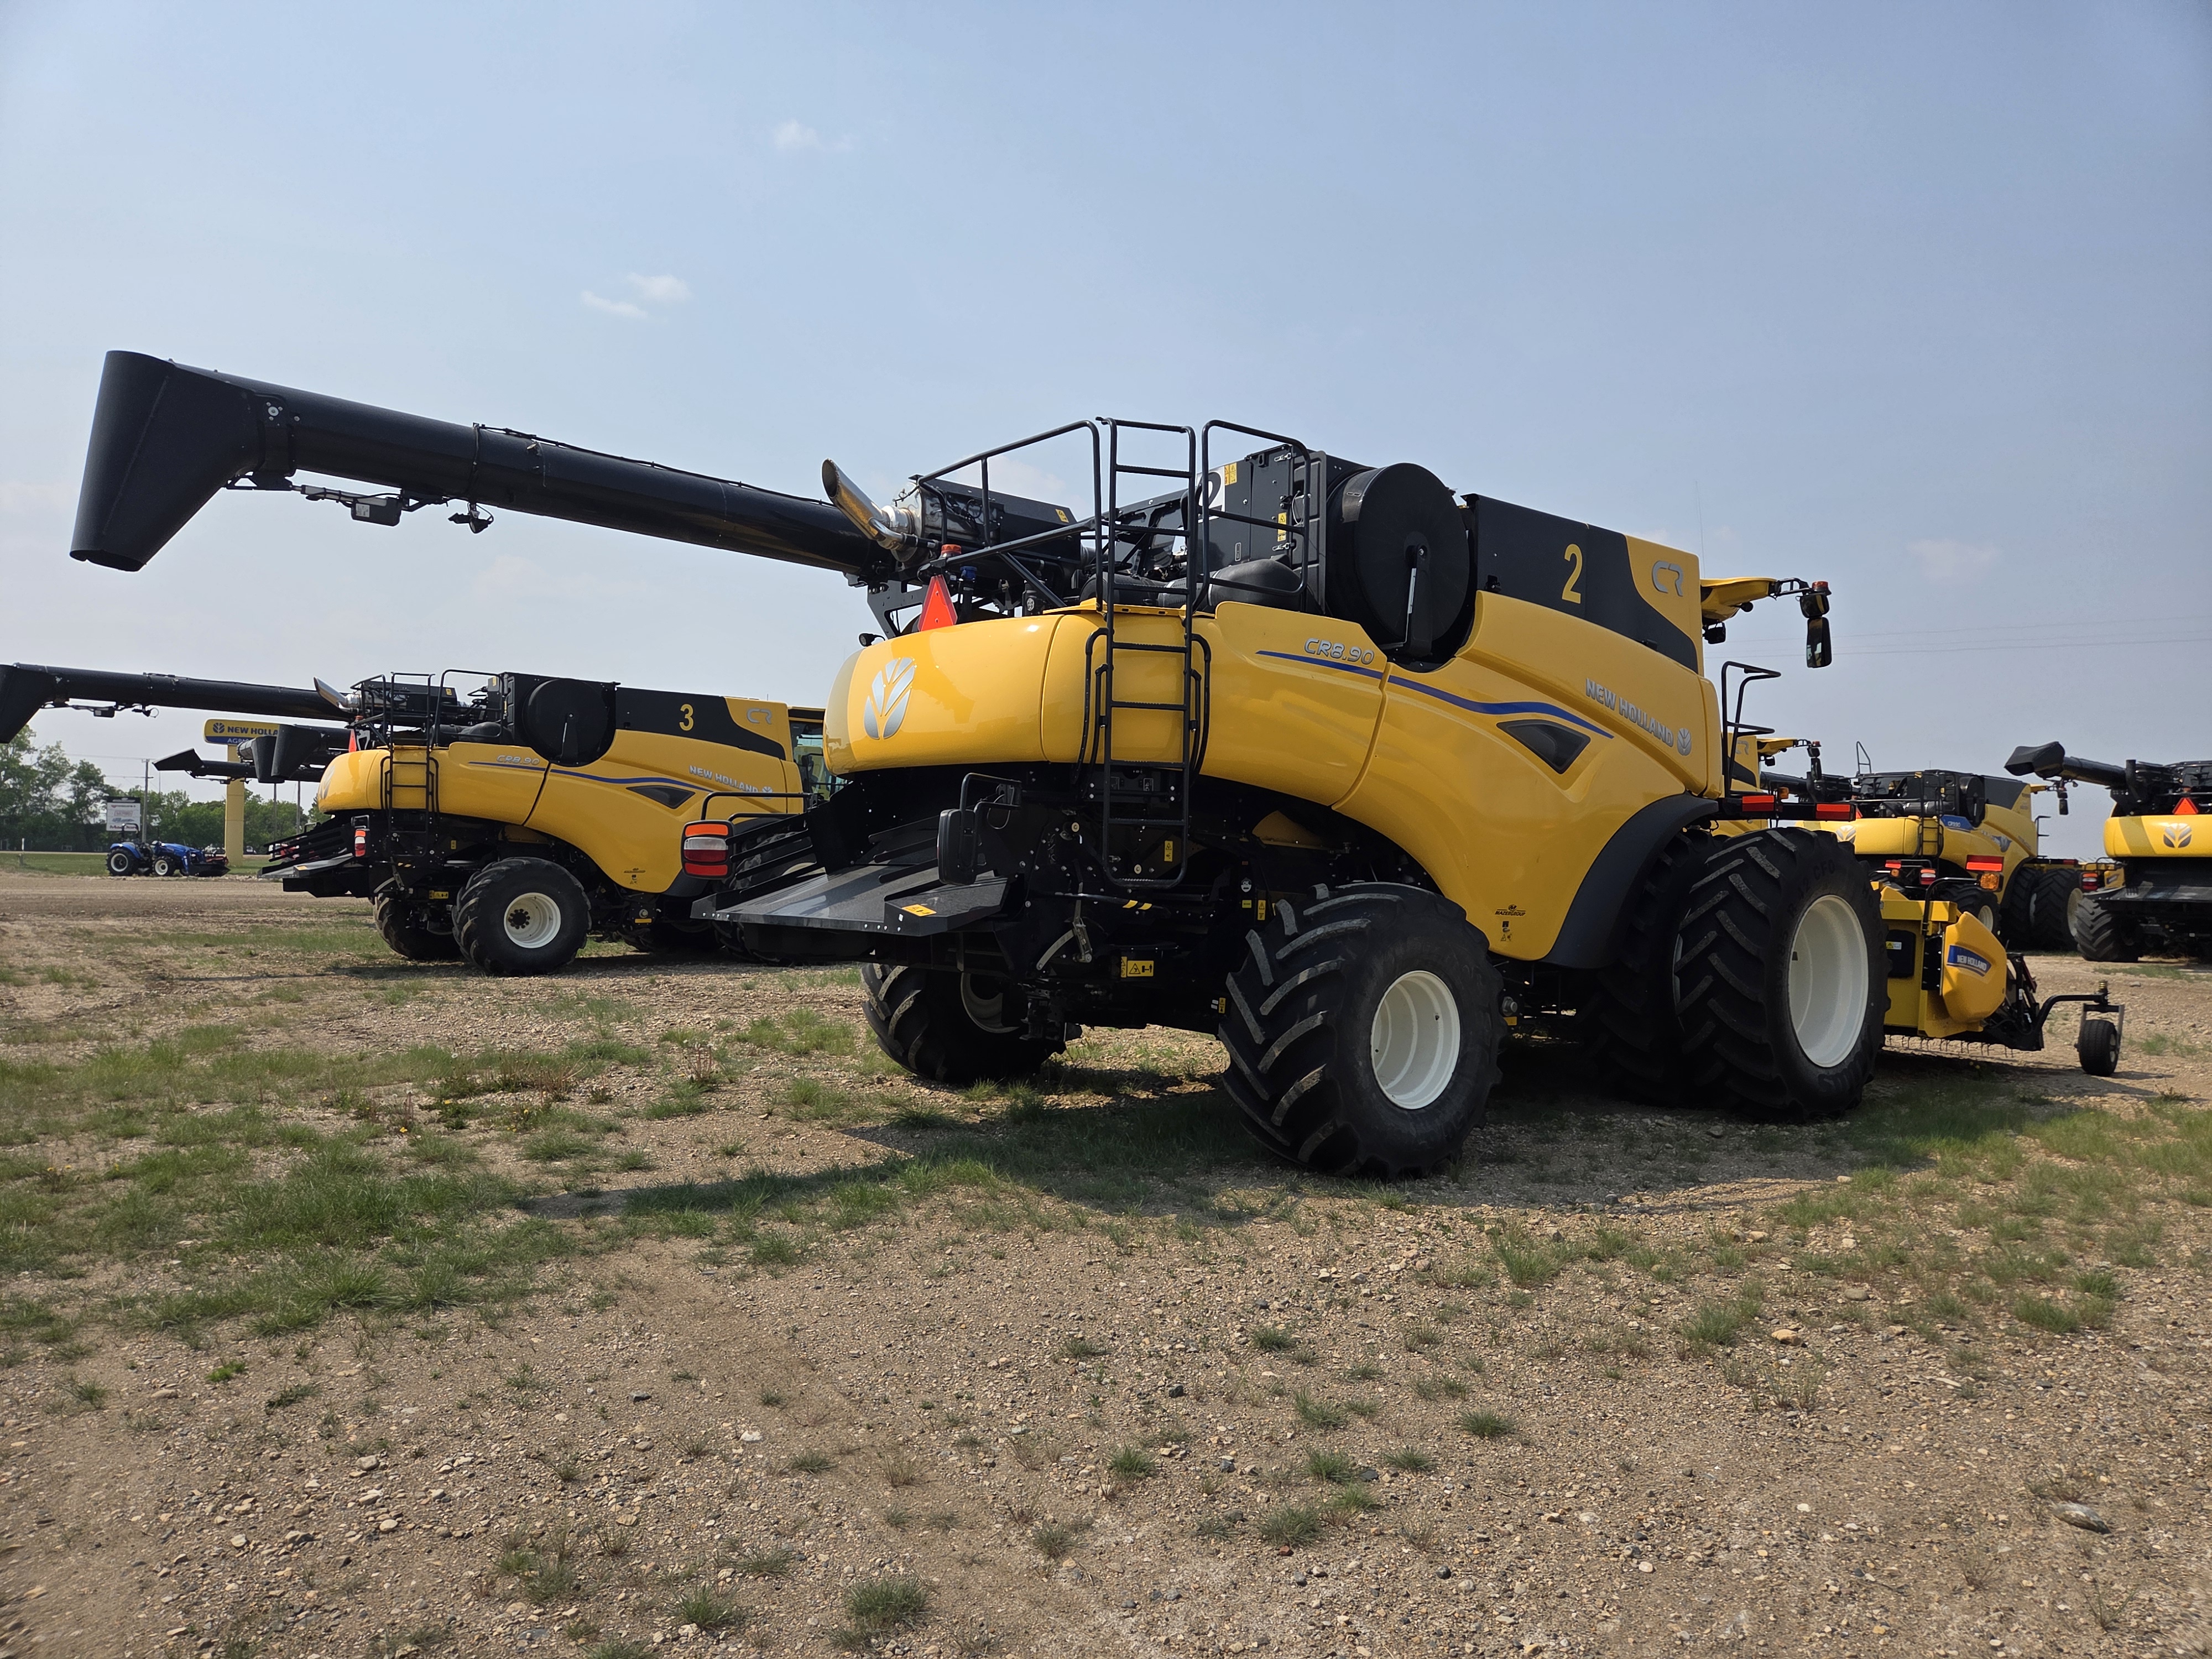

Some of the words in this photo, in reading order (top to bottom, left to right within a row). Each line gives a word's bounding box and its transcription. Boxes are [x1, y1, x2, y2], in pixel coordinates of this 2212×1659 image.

[1562, 544, 1583, 604] 2
[1652, 560, 1684, 597] CR
[1304, 638, 1375, 665] CR8.90
[679, 703, 694, 731] 3
[747, 707, 773, 725] CR
[1585, 677, 1617, 711] NEW
[1619, 697, 1674, 748] HOLLAND
[227, 726, 249, 734] NEW
[497, 755, 540, 765] CR8.90
[689, 765, 712, 779] NEW
[715, 773, 759, 792] HOLLAND
